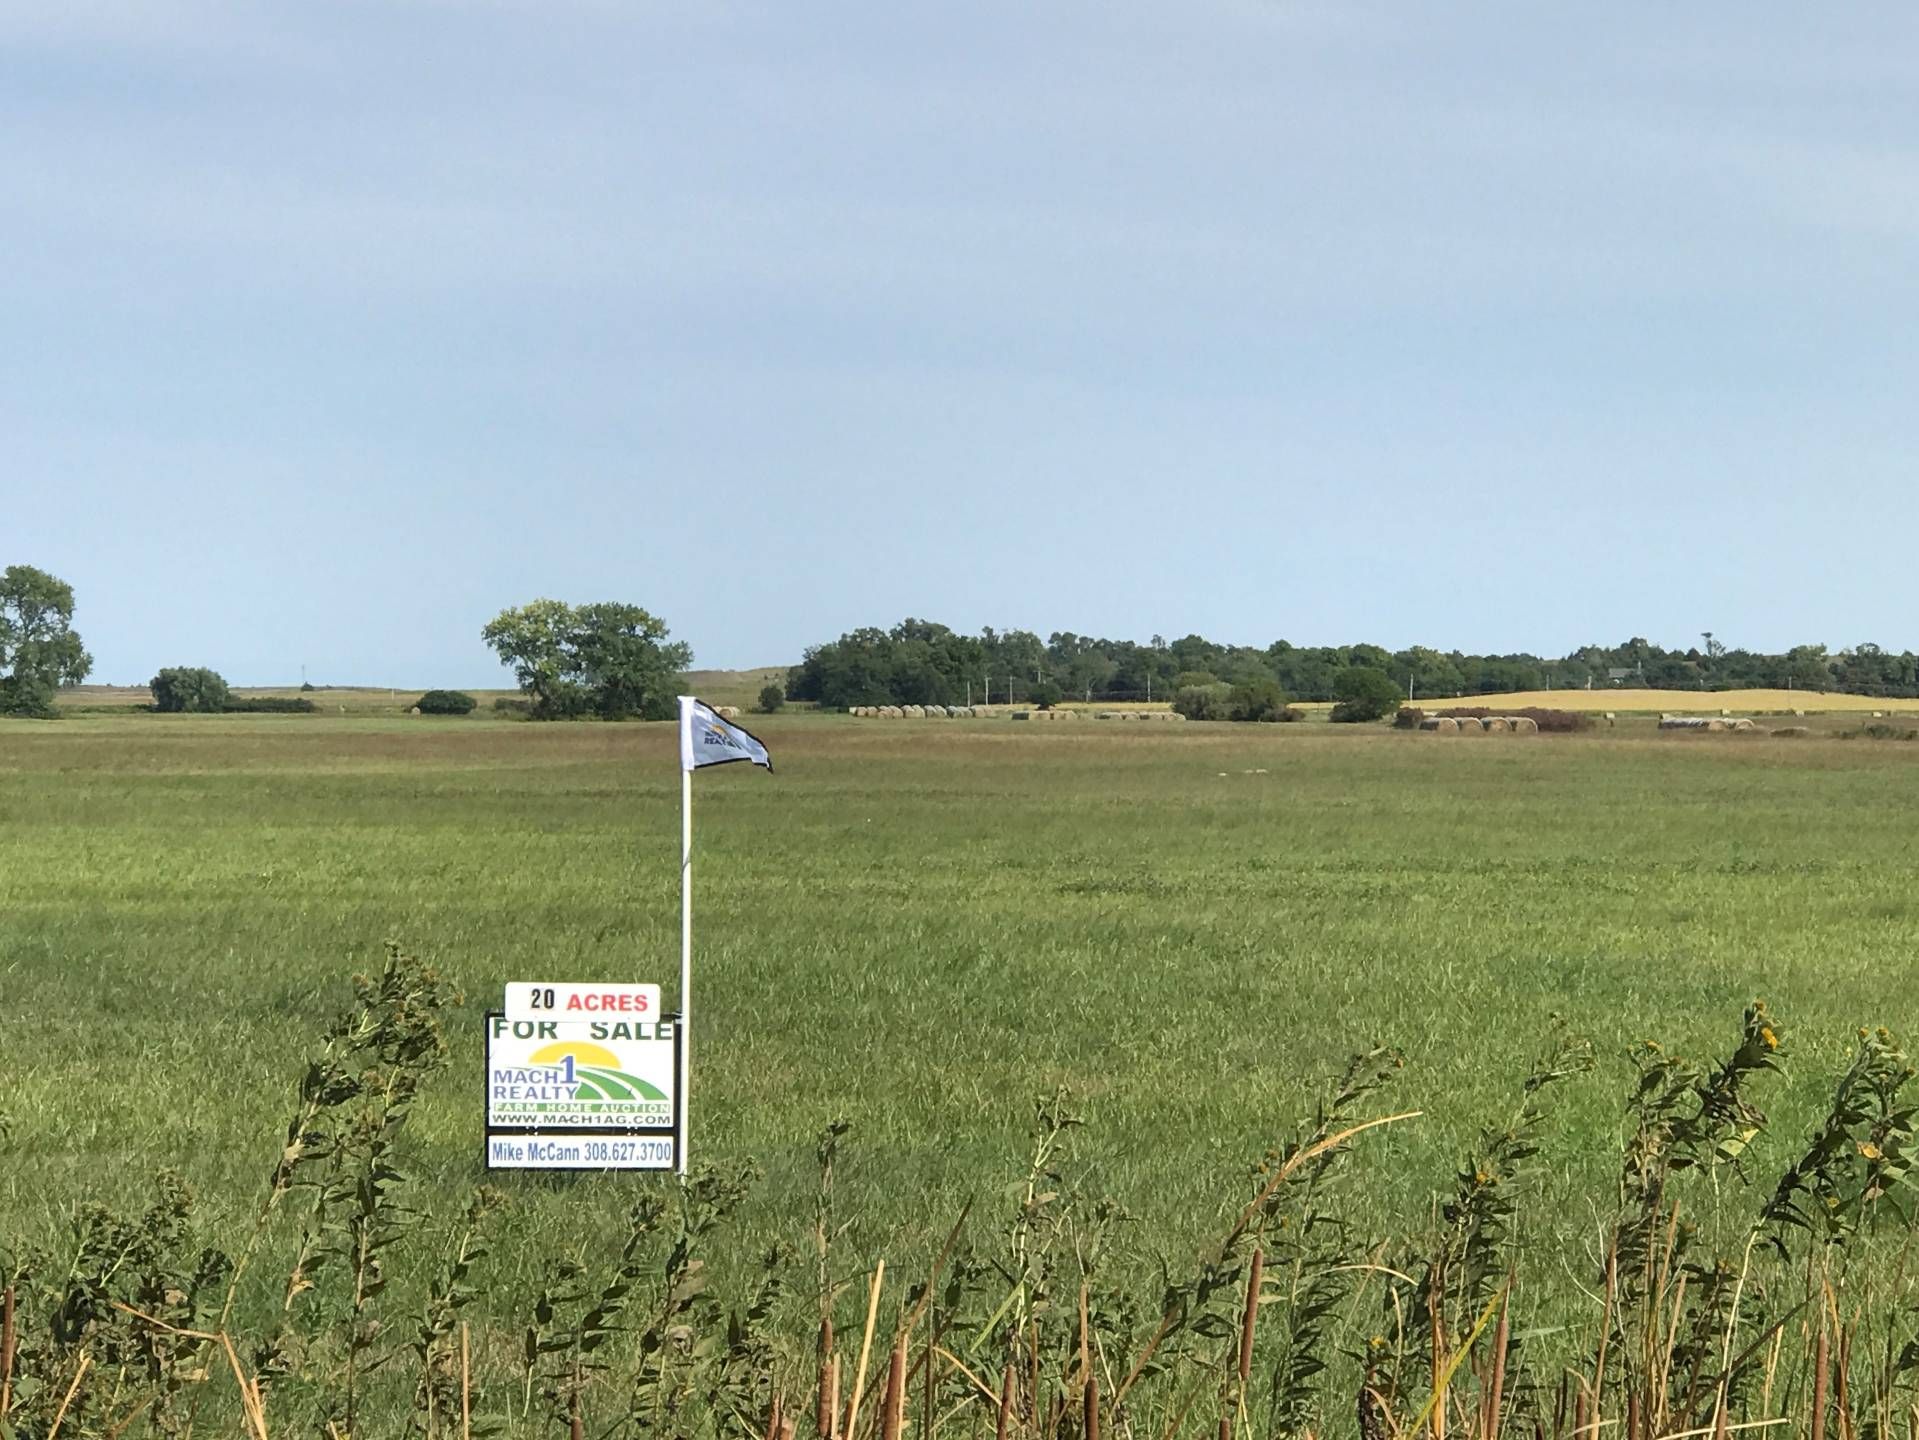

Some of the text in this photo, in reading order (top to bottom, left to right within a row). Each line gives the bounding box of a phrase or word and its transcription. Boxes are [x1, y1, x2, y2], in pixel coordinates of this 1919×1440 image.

[531, 988, 648, 1011] 20 ACRES
[493, 1018, 672, 1040] FOR SALE
[493, 1055, 579, 1084] MACH 1
[493, 1086, 578, 1100] REALTY
[494, 1103, 670, 1113] FARM HOME AUCTION
[492, 1114, 671, 1125] WWW.MACH1AG.COM
[492, 1142, 671, 1161] Mike McCann 308.627.3700
